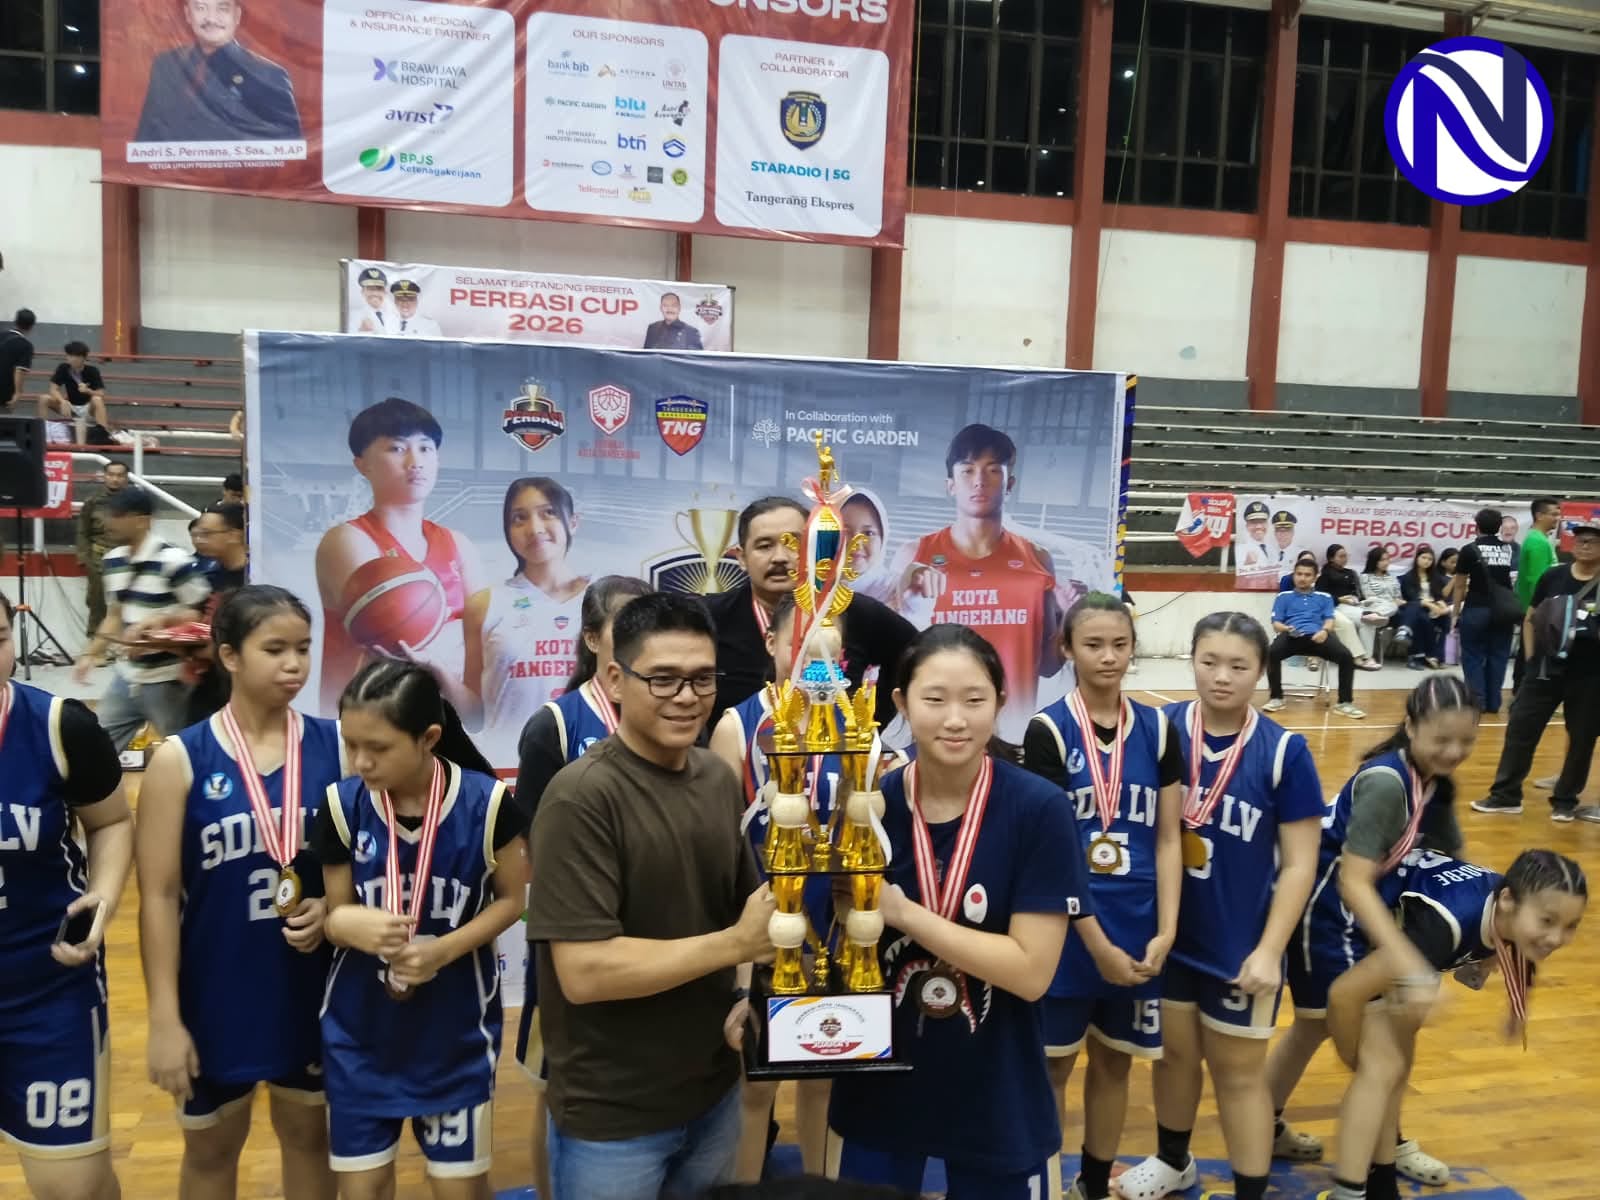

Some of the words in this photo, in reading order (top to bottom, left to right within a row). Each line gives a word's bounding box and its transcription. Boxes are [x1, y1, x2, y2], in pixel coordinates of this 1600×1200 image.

[365, 9, 417, 23] OFFICIAL
[423, 15, 478, 30] MEDICAL
[361, 22, 433, 36] INSURANCE
[435, 28, 491, 41] PARTNER
[572, 29, 598, 40] OUR
[600, 31, 665, 47] SPONSORS
[548, 59, 570, 71] bank
[572, 61, 589, 74] bjb
[774, 52, 825, 66] PARTNER
[401, 61, 467, 77] BRAWIJAYA
[760, 62, 849, 79] COLLABORATOR
[401, 75, 459, 89] HOSPITAL
[615, 96, 646, 111] blu
[617, 133, 647, 150] btn
[131, 147, 163, 158] Andri
[400, 152, 434, 166] BPJS
[751, 160, 822, 178] STARADIO
[745, 191, 808, 208] Tangerang
[811, 196, 855, 211] Ekspres
[455, 276, 508, 288] SELAMAT
[511, 279, 582, 292] BERTANDING
[585, 284, 634, 295] PESERTA
[449, 288, 574, 313] PERBASI
[580, 297, 639, 316] CUP
[508, 314, 583, 335] 2026
[785, 410, 795, 420] In
[797, 410, 867, 423] Collaboration
[870, 413, 893, 424] with
[662, 420, 702, 436] TNG
[852, 430, 919, 446] GARDEN
[1325, 506, 1370, 515] SELAMAT
[1436, 510, 1476, 519] PESERT
[1321, 518, 1425, 538] PERBASI
[1431, 522, 1479, 540] CUP
[952, 589, 999, 606] KOTA
[535, 639, 577, 656] KOT
[1132, 999, 1160, 1034] 15
